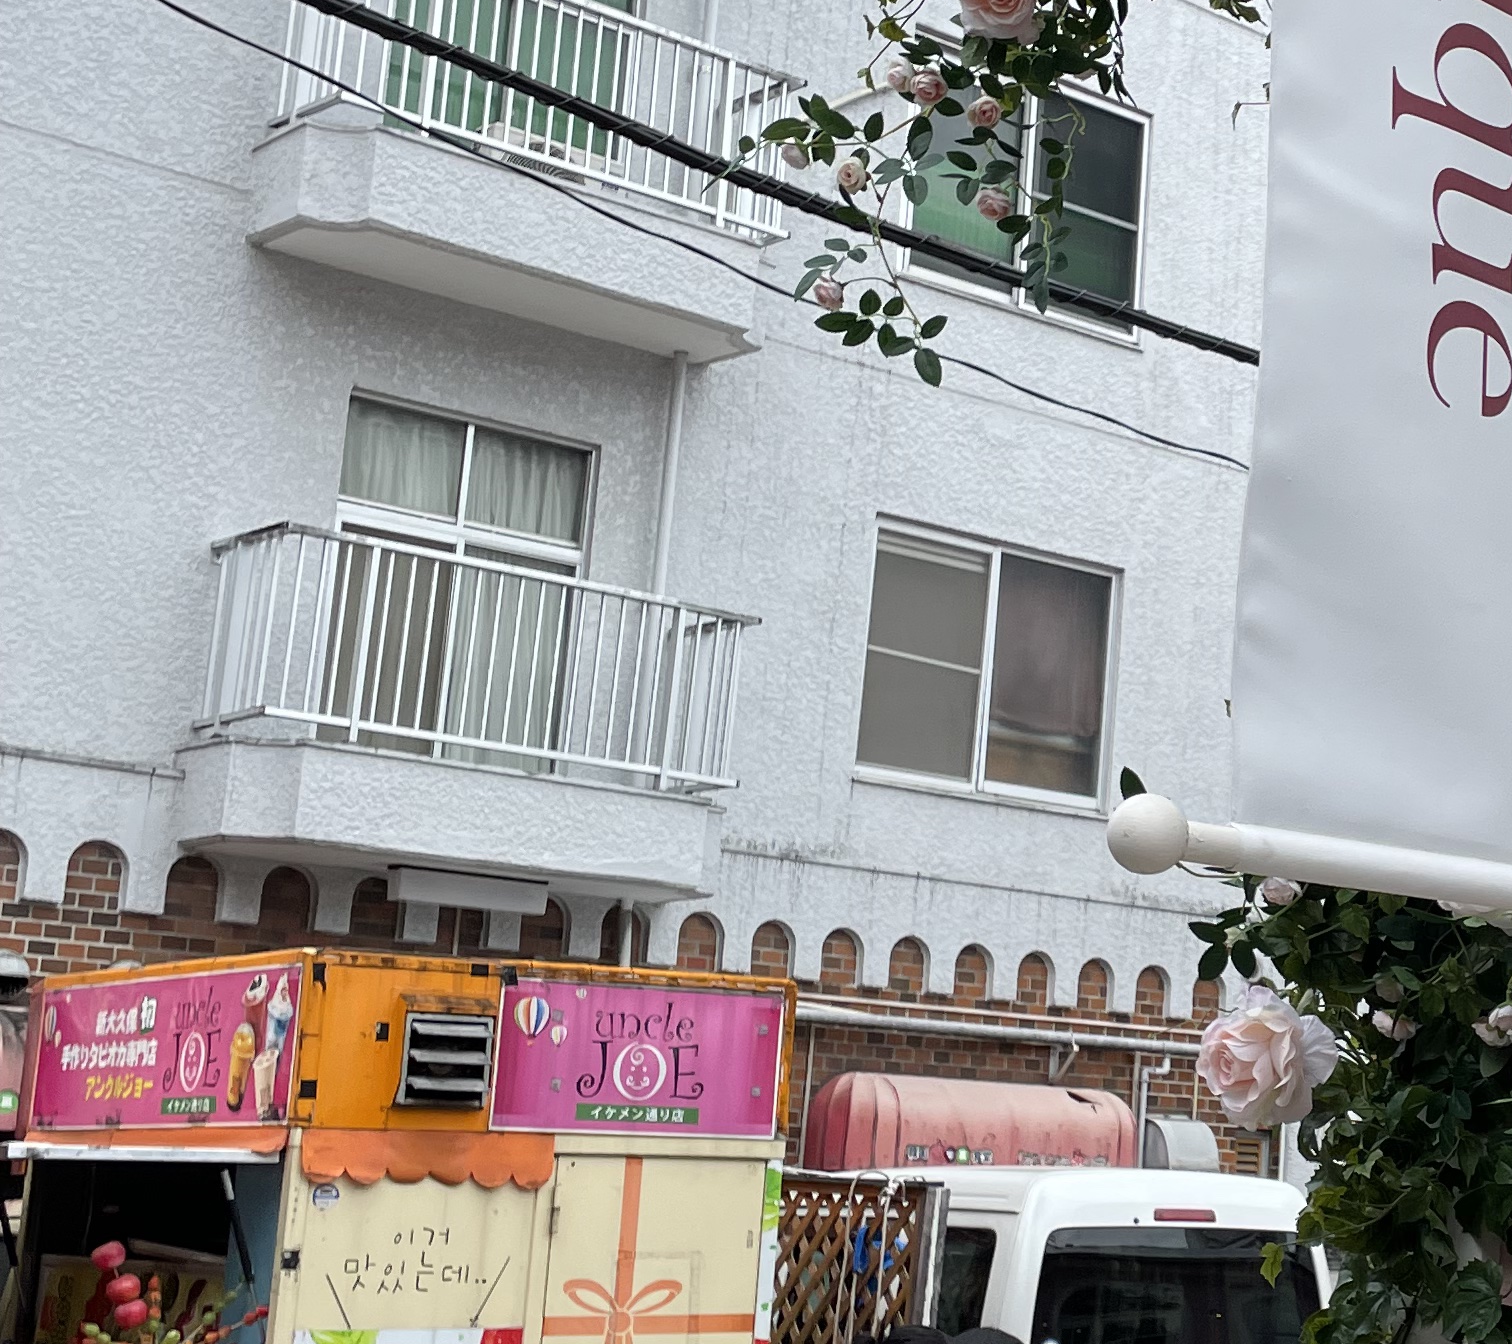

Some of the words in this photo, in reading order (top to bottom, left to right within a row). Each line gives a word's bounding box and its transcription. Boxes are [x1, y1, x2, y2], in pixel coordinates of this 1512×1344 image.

[175, 985, 222, 1031] uncle
[595, 1002, 695, 1042] uncle
[162, 1028, 222, 1093] JOE
[576, 1040, 704, 1101] JOE
[84, 1072, 154, 1102] アンクルジョー
[590, 1105, 685, 1124] イケメン通り店
[393, 1226, 451, 1246] 이거
